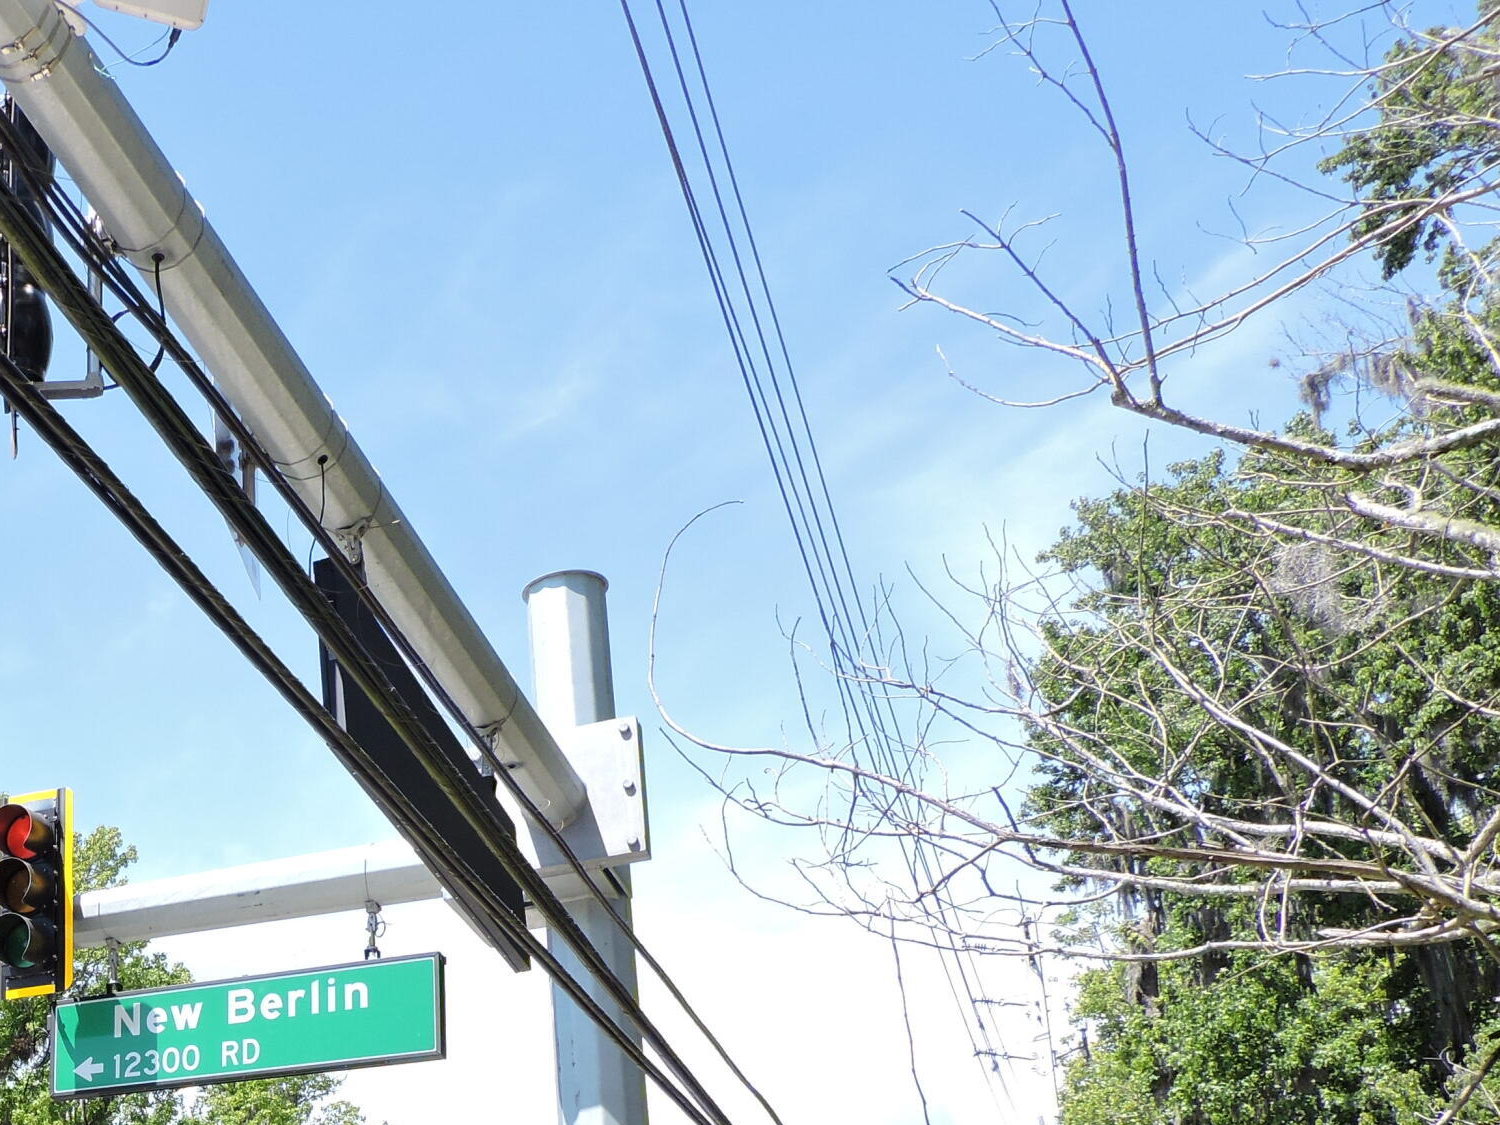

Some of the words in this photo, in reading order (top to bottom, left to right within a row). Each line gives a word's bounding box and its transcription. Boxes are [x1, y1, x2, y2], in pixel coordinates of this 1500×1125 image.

[113, 1001, 203, 1038] New
[227, 977, 369, 1025] Berlin
[113, 1044, 200, 1079] 12300
[221, 1038, 260, 1067] RD
